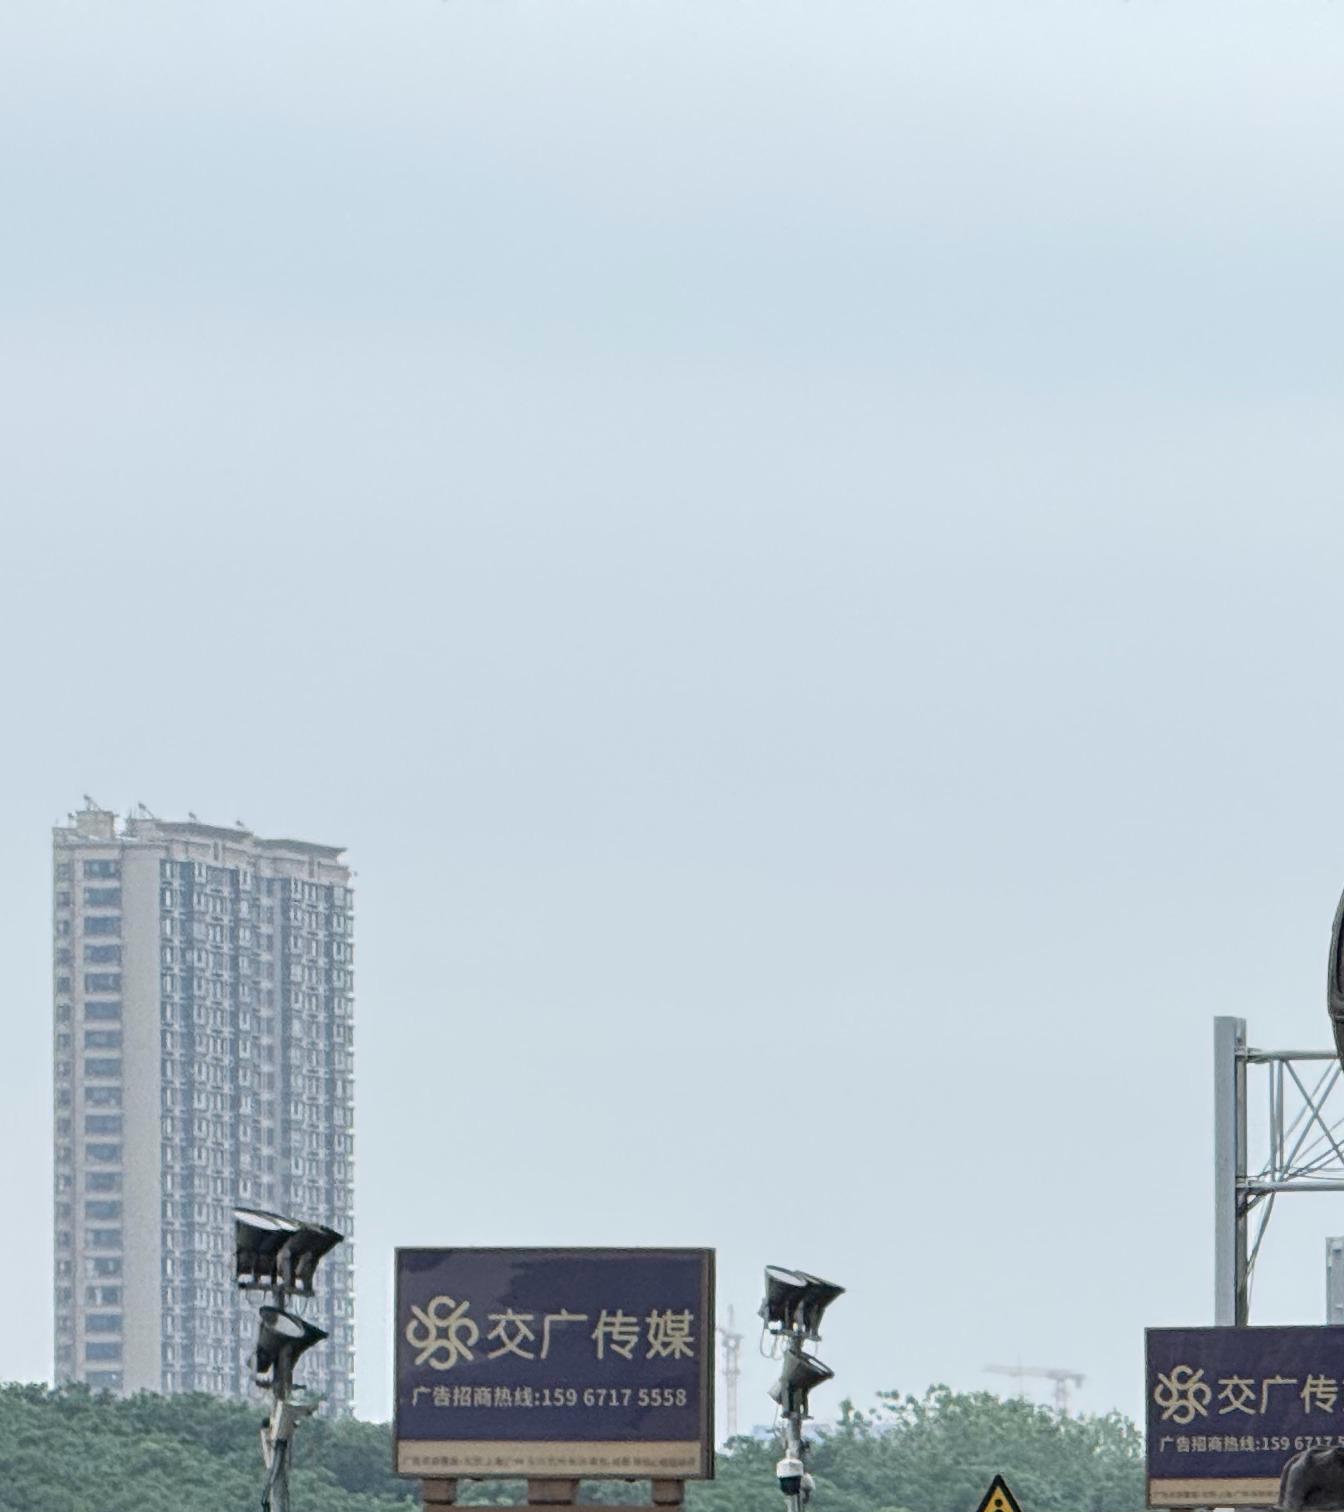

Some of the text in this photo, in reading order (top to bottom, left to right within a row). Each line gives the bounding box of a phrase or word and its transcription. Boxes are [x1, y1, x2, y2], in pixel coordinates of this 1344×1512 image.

[487, 1308, 695, 1361] 交广传媒
[583, 1387, 630, 1407] 6717
[637, 1387, 687, 1407] 5558
